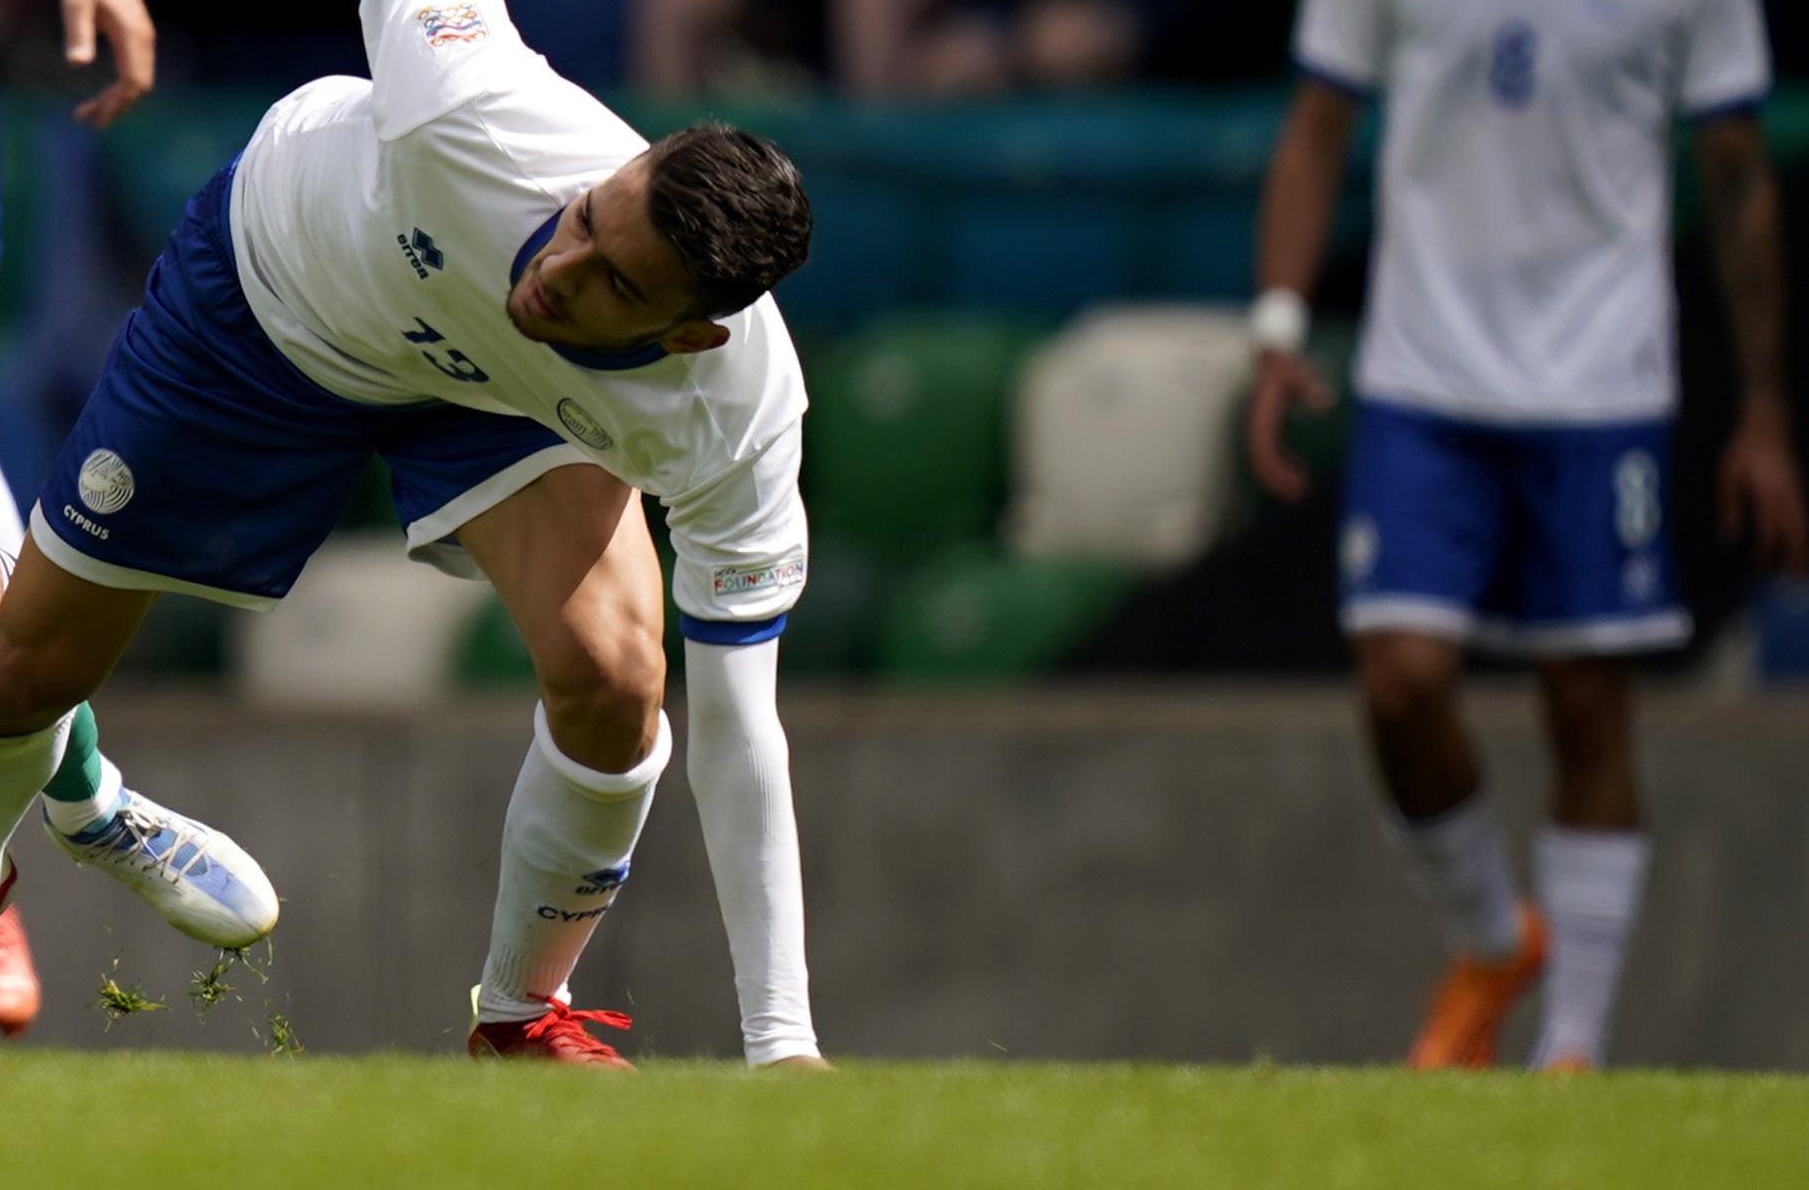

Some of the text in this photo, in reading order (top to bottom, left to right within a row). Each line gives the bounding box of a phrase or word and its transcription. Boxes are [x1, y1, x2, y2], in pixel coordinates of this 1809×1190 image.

[1612, 447, 1662, 548] 8
[63, 504, 110, 540] CYPRUS
[714, 563, 803, 594] FOUNDATION
